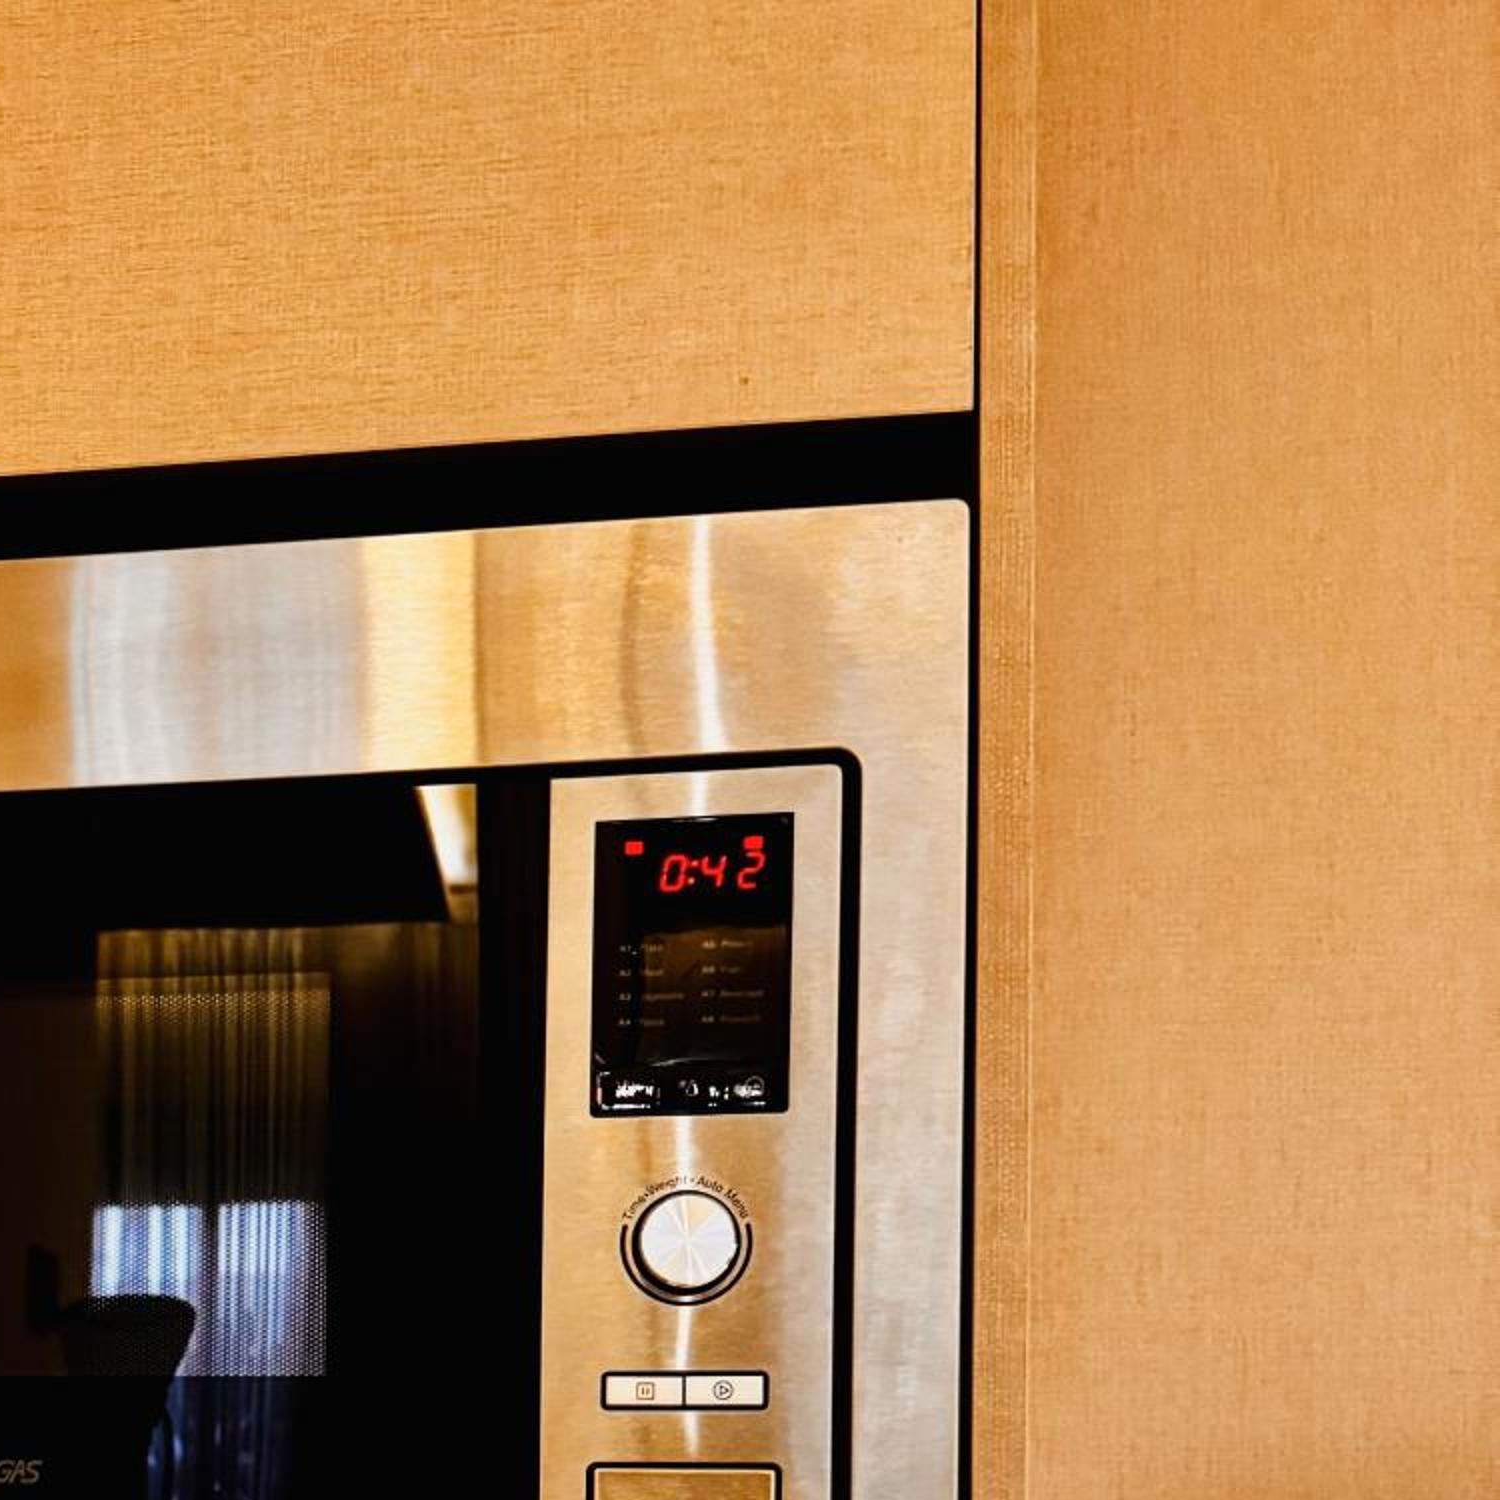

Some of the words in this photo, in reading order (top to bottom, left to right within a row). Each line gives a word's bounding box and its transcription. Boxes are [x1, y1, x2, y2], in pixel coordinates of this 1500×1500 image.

[660, 852, 765, 892] 0:42
[696, 1176, 723, 1194] Auto
[724, 1189, 751, 1220] Menu
